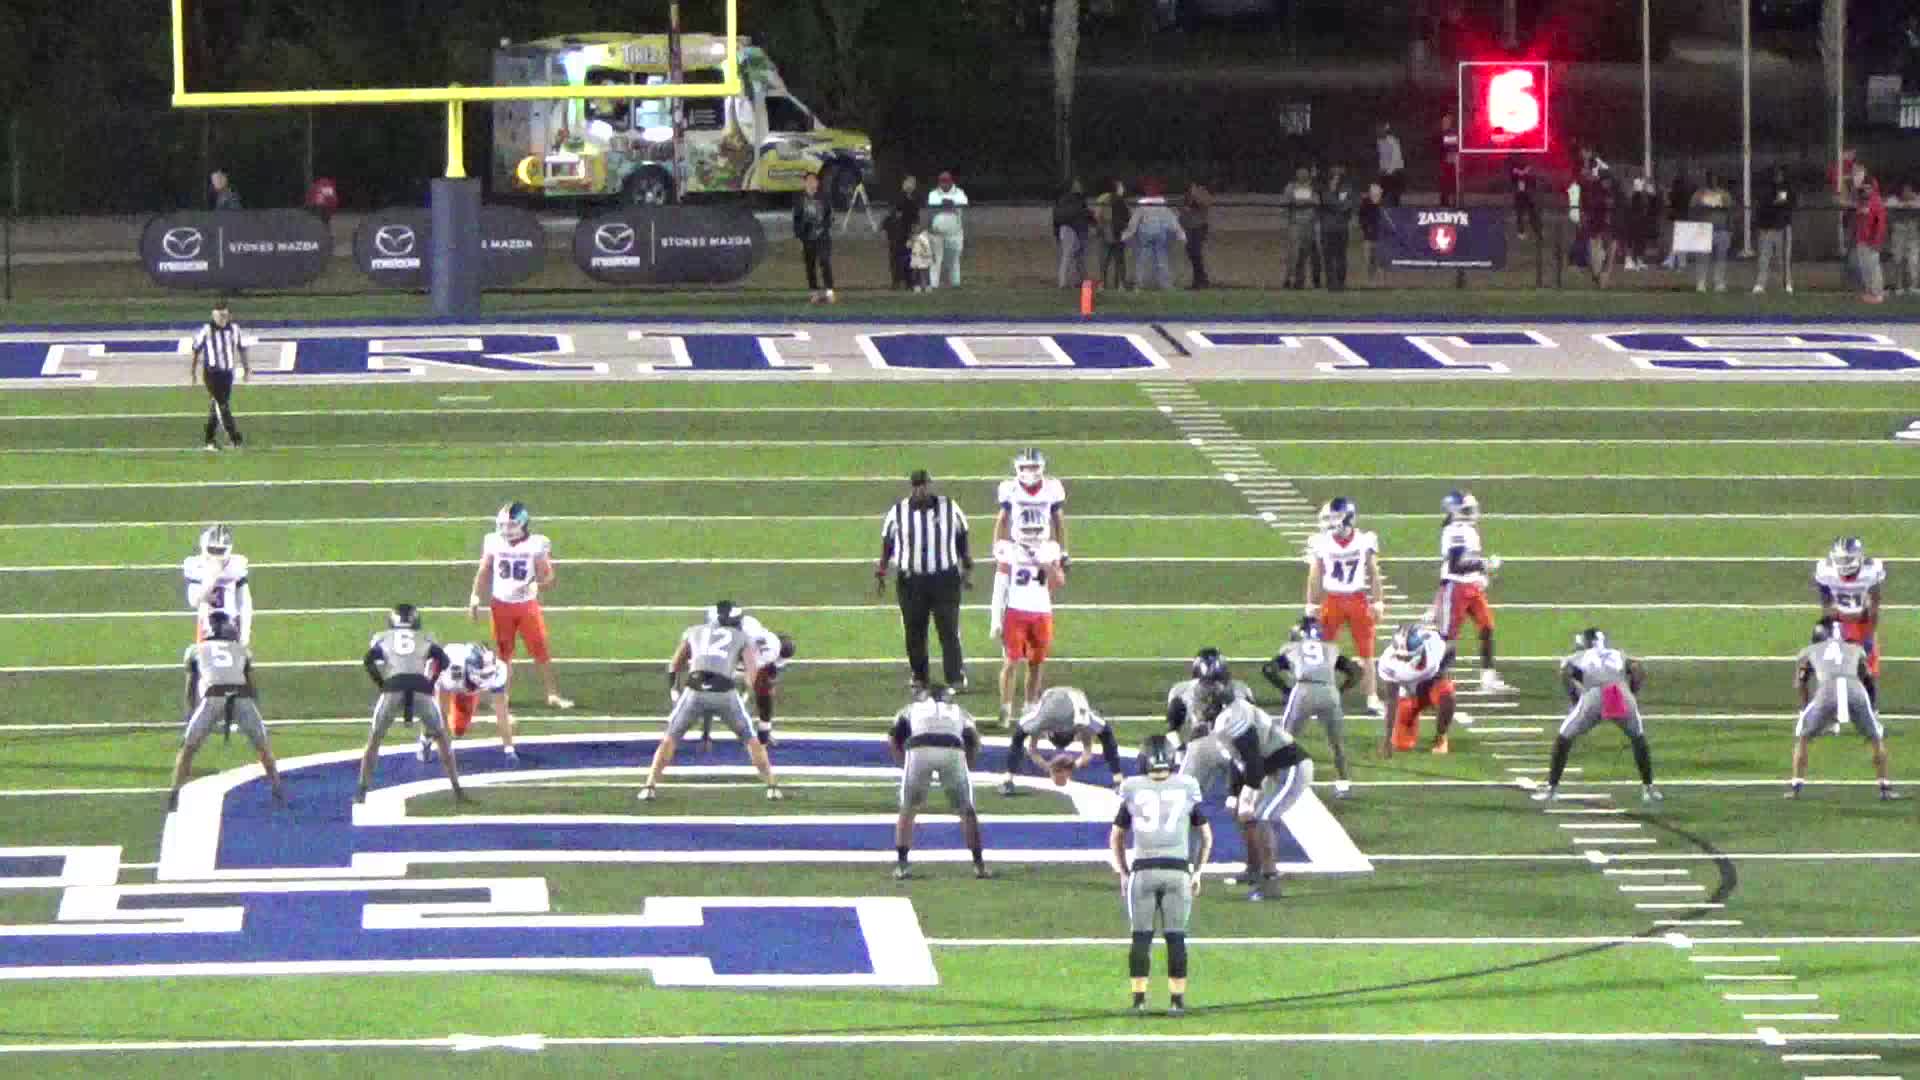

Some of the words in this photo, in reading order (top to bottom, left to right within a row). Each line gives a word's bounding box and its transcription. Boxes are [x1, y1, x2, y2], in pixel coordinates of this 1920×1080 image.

[1488, 69, 1540, 133] 6
[228, 241, 274, 252] STOKES
[278, 240, 319, 251] MAZDA
[490, 239, 533, 249] MAZDA
[660, 237, 706, 248] STOKES
[710, 236, 751, 247] MAZDA
[498, 559, 528, 581] 36
[1330, 558, 1360, 584] 47
[210, 640, 233, 667] 5
[393, 630, 416, 656] 6
[701, 627, 733, 659] 12
[1134, 788, 1188, 833] 37
